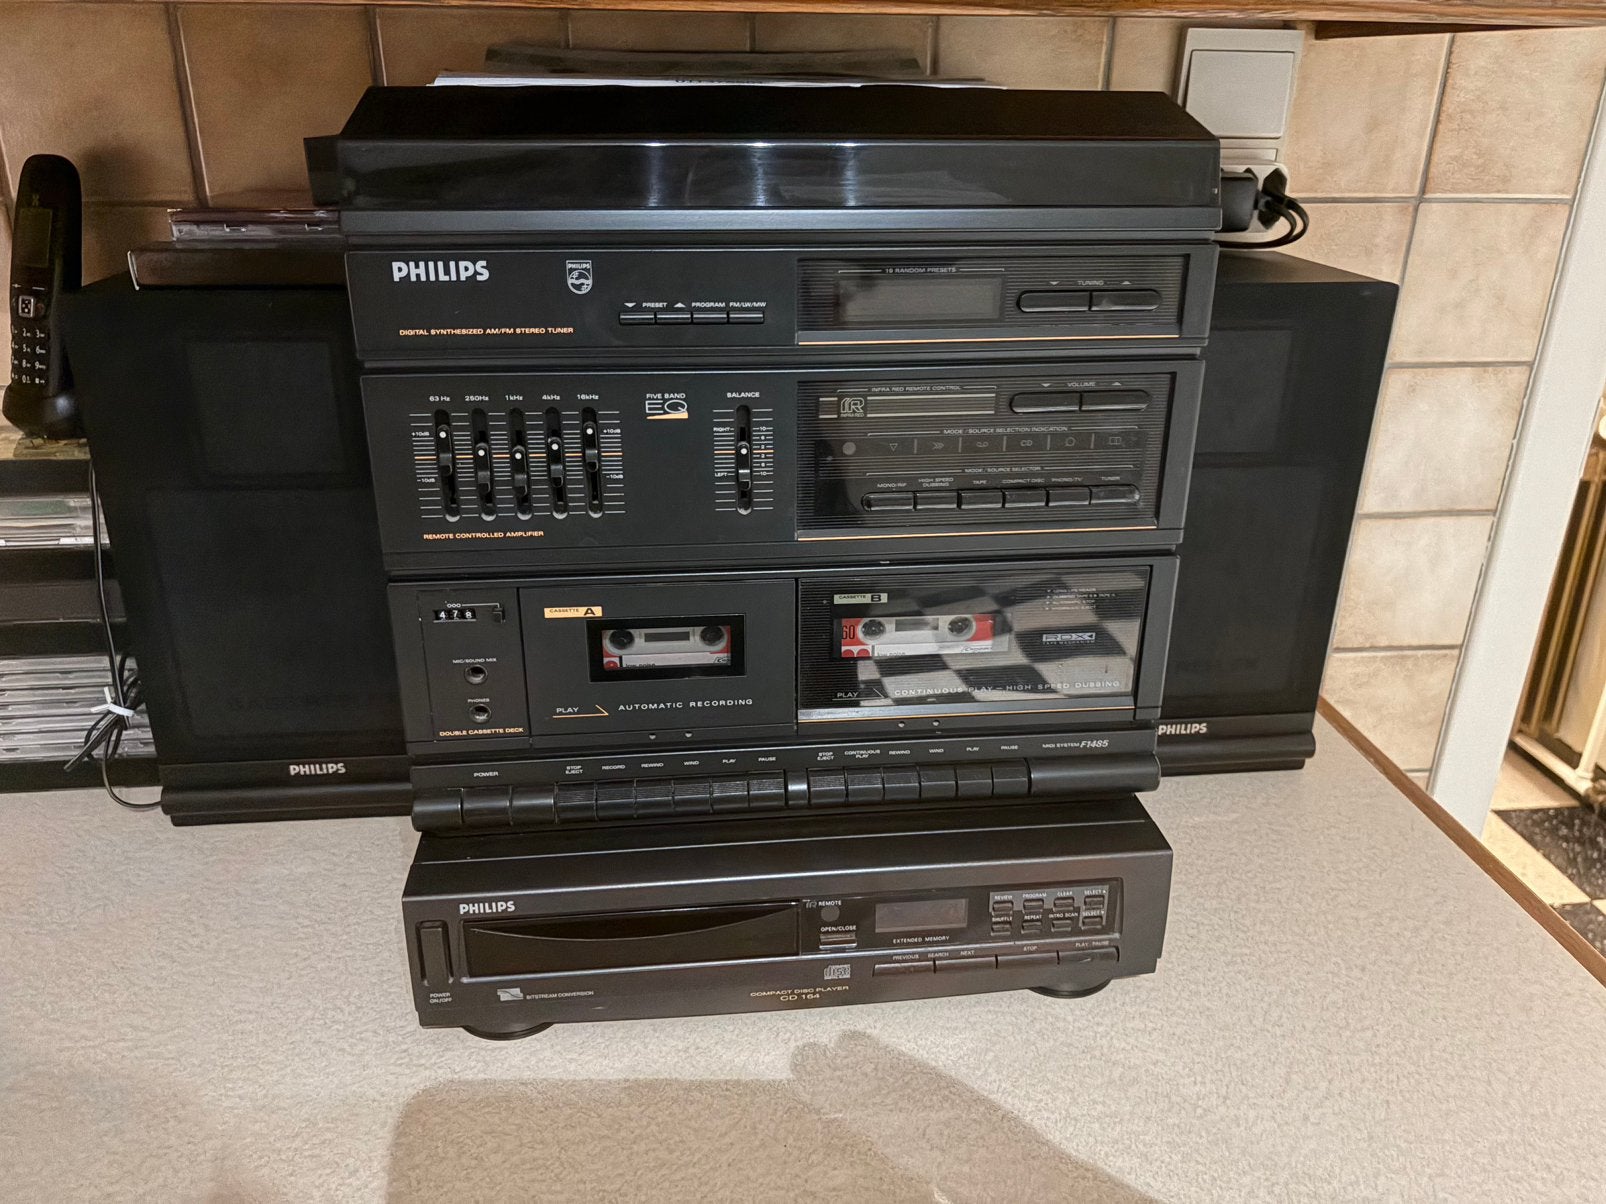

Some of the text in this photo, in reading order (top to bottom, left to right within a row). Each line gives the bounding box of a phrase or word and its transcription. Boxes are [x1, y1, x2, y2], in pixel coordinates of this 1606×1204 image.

[391, 260, 490, 282] PHILIPS
[430, 328, 484, 336] SYNTHESIZED
[465, 394, 489, 402] 250Hz
[541, 393, 561, 401] 4kHz
[576, 393, 599, 401] 16kHz
[645, 399, 688, 414] EQ
[423, 530, 544, 541] REMOTE CONTROLLED AMPLIFIER
[871, 594, 882, 602] B
[583, 607, 596, 616] A
[842, 624, 856, 640] 60
[894, 687, 965, 696] CONTINUOUS
[967, 685, 994, 693] PLAY
[1037, 682, 1070, 690] SPEED
[1074, 680, 1120, 688] DUBBING
[618, 702, 684, 711] AUTOMATIC
[689, 699, 753, 708] RECORDING
[468, 728, 505, 736] CASSETTE
[1158, 722, 1207, 736] PHILIPS
[1080, 739, 1110, 748] F1485
[289, 762, 346, 776] PHILIPS
[459, 901, 515, 915] PHILIPS
[558, 990, 594, 998] CONVERSION
[750, 989, 793, 997] COMPACT
